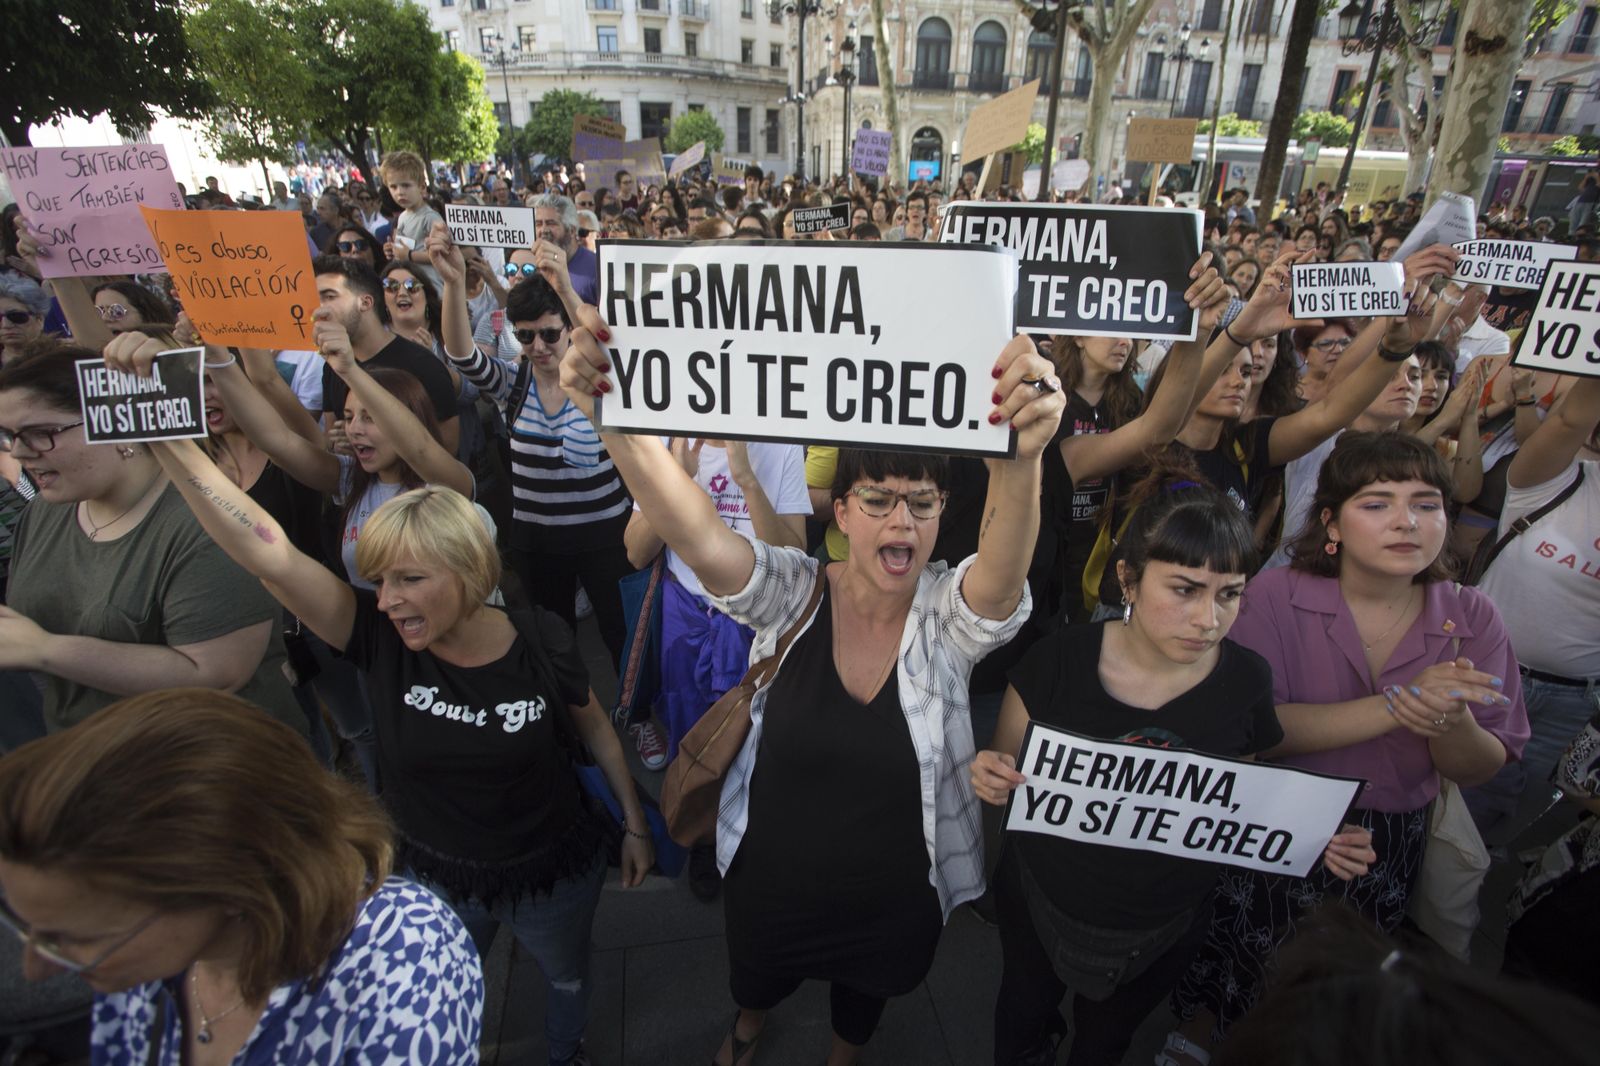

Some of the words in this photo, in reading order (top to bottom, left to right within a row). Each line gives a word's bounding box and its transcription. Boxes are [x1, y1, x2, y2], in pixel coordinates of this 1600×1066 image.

[3, 150, 38, 180] HAY
[26, 190, 63, 212] QUE
[448, 208, 507, 228] HERMANA,
[796, 222, 806, 232] YO
[815, 220, 824, 230] TE
[38, 223, 77, 246] SON
[175, 243, 202, 264] es
[211, 231, 272, 262] abuso,
[450, 227, 465, 243] YO
[467, 225, 478, 242] SÍ
[480, 228, 494, 243] TE
[497, 229, 529, 245] CREO.
[68, 243, 164, 272] AGRESIO
[1474, 259, 1491, 279] SÍ
[1494, 263, 1513, 281] TE
[1515, 266, 1546, 284] CRE
[1297, 267, 1376, 289] HERMANA,
[1545, 272, 1600, 313] HE
[606, 261, 881, 345] HERMANA,
[1028, 274, 1069, 318] TE
[1077, 276, 1175, 324] CREO.
[1298, 293, 1317, 312] YO
[1322, 289, 1335, 312] SÍ
[1339, 292, 1357, 311] TE
[1361, 291, 1401, 310] CREO.
[1533, 320, 1581, 360] YO
[609, 347, 671, 412] YO
[687, 339, 731, 416] SÍ
[747, 353, 808, 420] TE
[826, 357, 980, 431] CREO.
[88, 405, 113, 434] YO
[115, 397, 135, 433] SÍ
[136, 401, 156, 431] TE
[155, 397, 197, 430] CREO.
[1535, 541, 1558, 558] IS
[1557, 554, 1576, 569] A
[1032, 738, 1240, 814] HERMANA,
[1025, 785, 1073, 826] YO
[1079, 796, 1124, 837] SÍ
[1130, 805, 1180, 844] TE
[1182, 816, 1293, 867] CREO.
